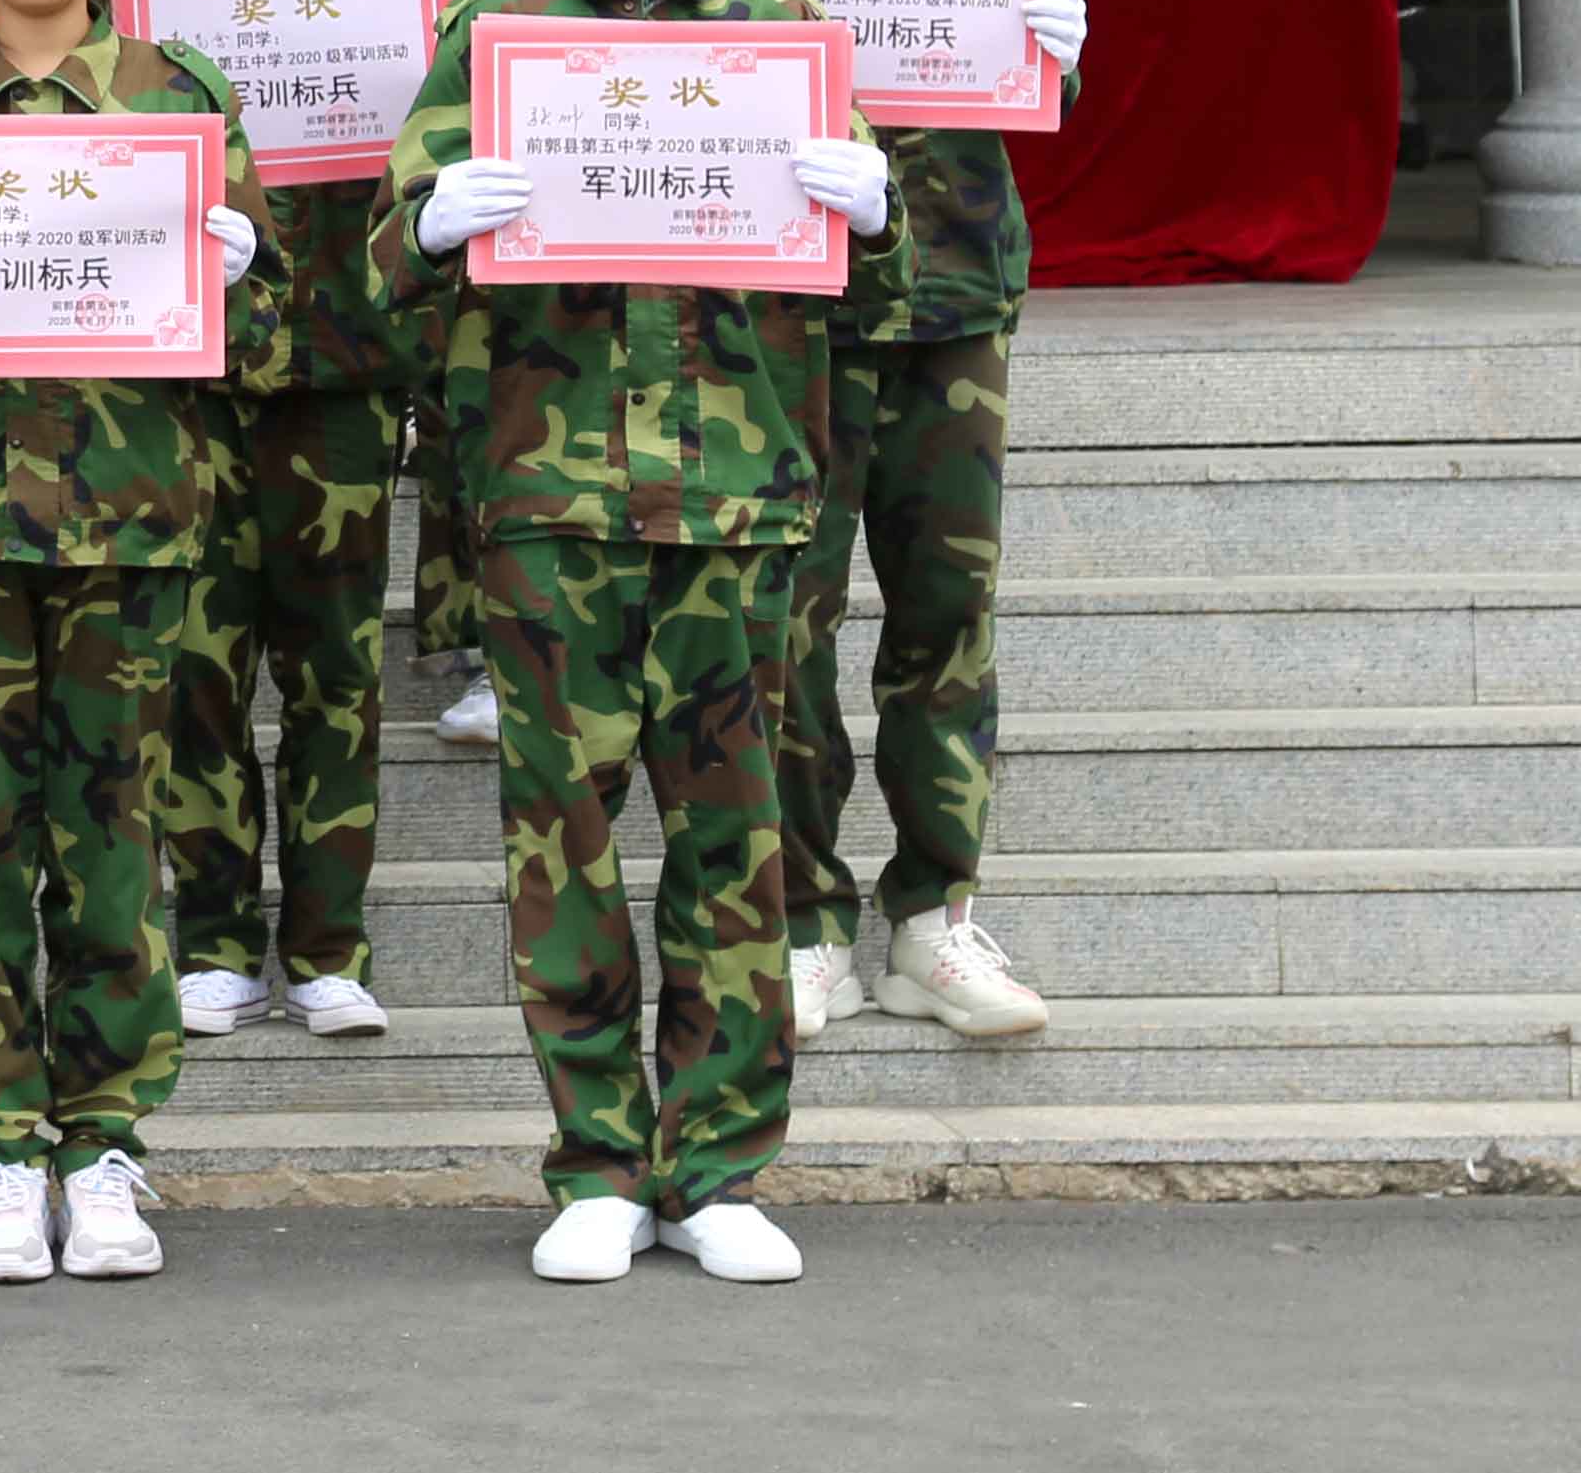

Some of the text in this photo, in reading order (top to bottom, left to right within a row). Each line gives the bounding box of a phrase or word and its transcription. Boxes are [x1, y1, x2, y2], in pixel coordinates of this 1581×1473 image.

[829, 16, 957, 49] 训标兵
[599, 76, 721, 108] 奖状
[581, 166, 734, 200] 军训标兵
